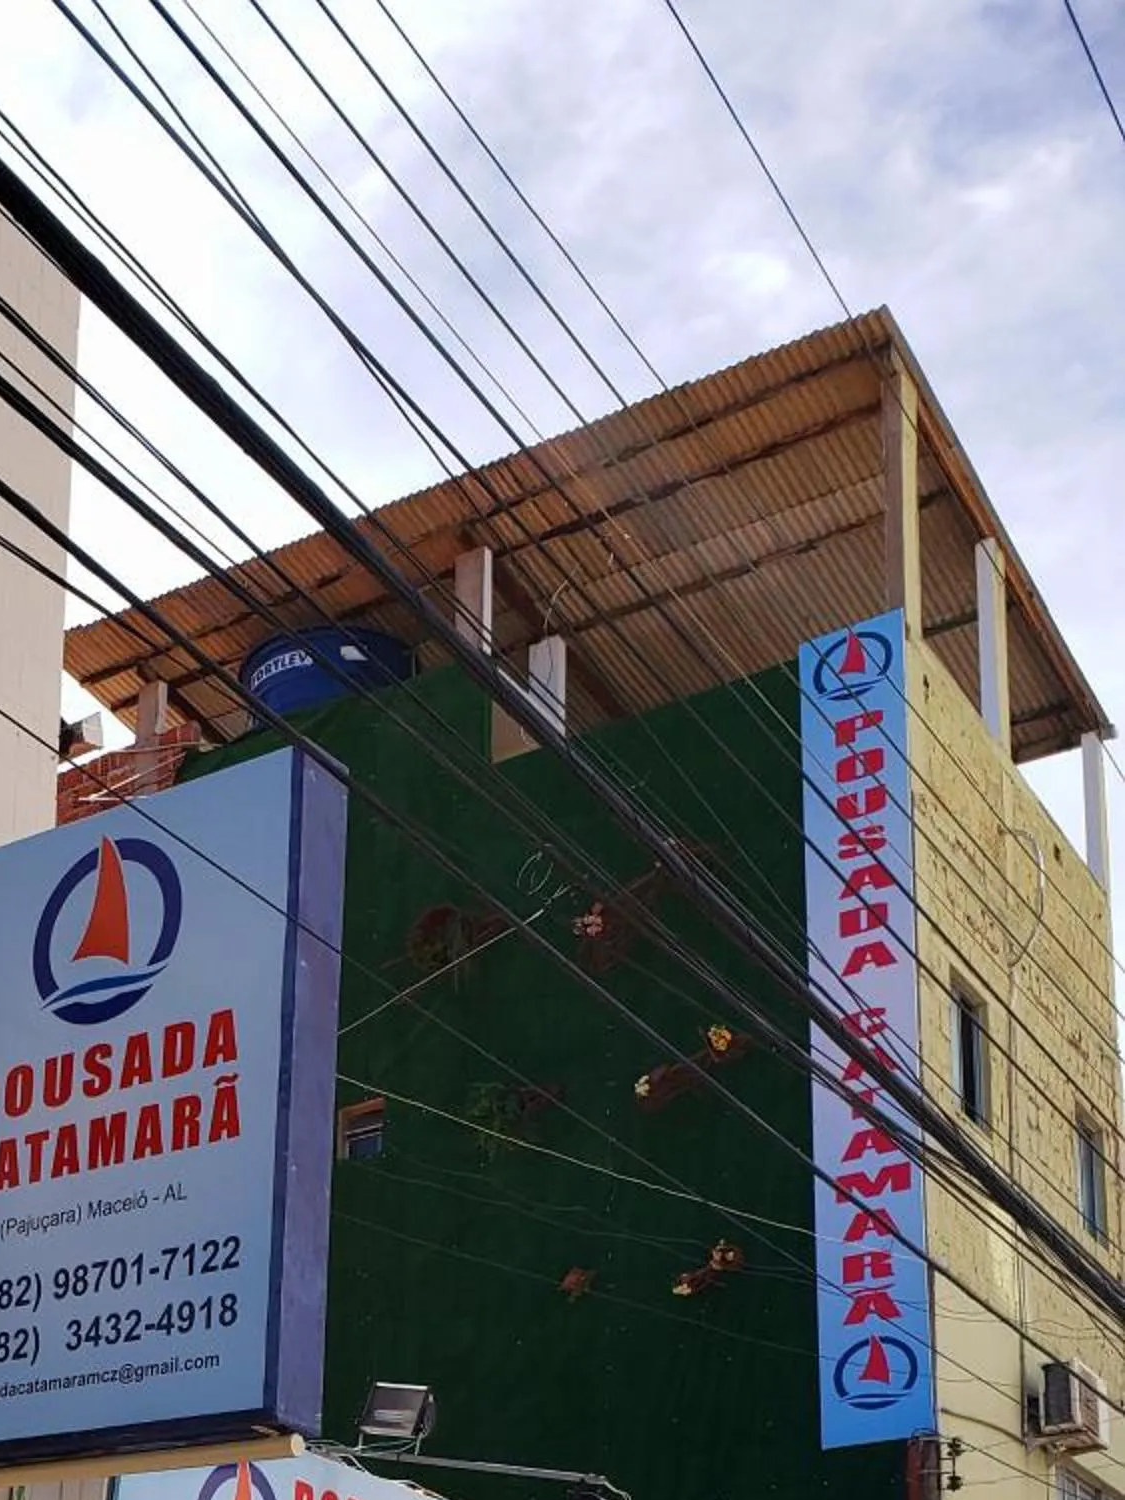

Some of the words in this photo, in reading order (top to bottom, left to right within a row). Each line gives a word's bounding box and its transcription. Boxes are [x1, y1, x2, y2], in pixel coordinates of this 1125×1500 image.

[835, 709, 898, 978] POUSADA
[0, 1204, 82, 1240] (Pajuçara)
[87, 1189, 148, 1219] Maceió
[163, 1182, 187, 1203] AL
[53, 1235, 241, 1301] 98701-7122
[65, 1292, 239, 1351] 3432-4918
